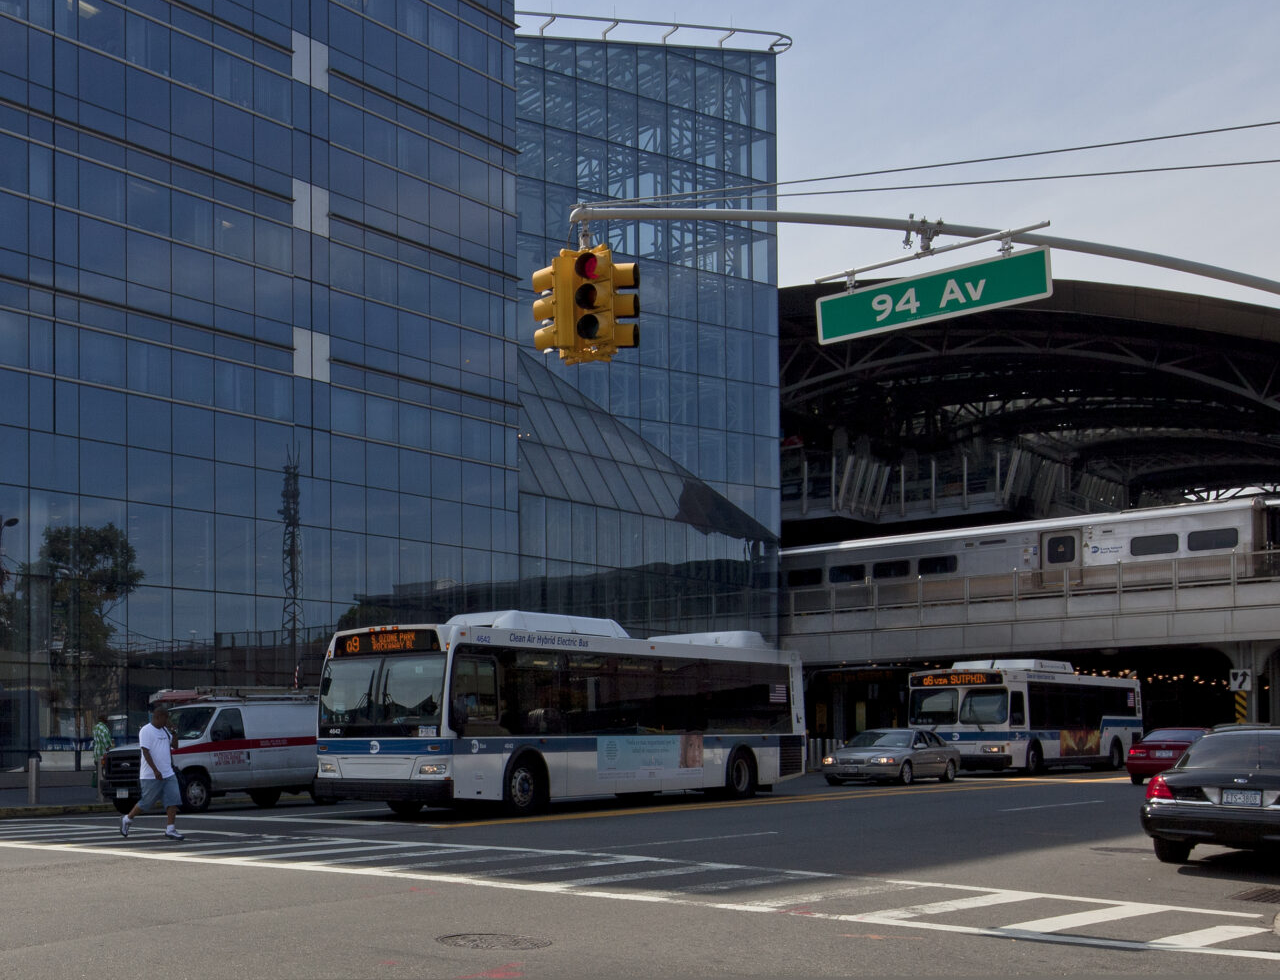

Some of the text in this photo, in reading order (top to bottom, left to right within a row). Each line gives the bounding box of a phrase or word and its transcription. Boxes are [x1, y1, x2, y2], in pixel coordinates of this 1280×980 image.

[872, 278, 986, 322] 94 Av
[346, 636, 360, 652] Q9
[399, 631, 415, 642] PARK
[509, 633, 589, 648] Clean Air Hybrid Electric Bus
[950, 673, 987, 685] SUTPHIN
